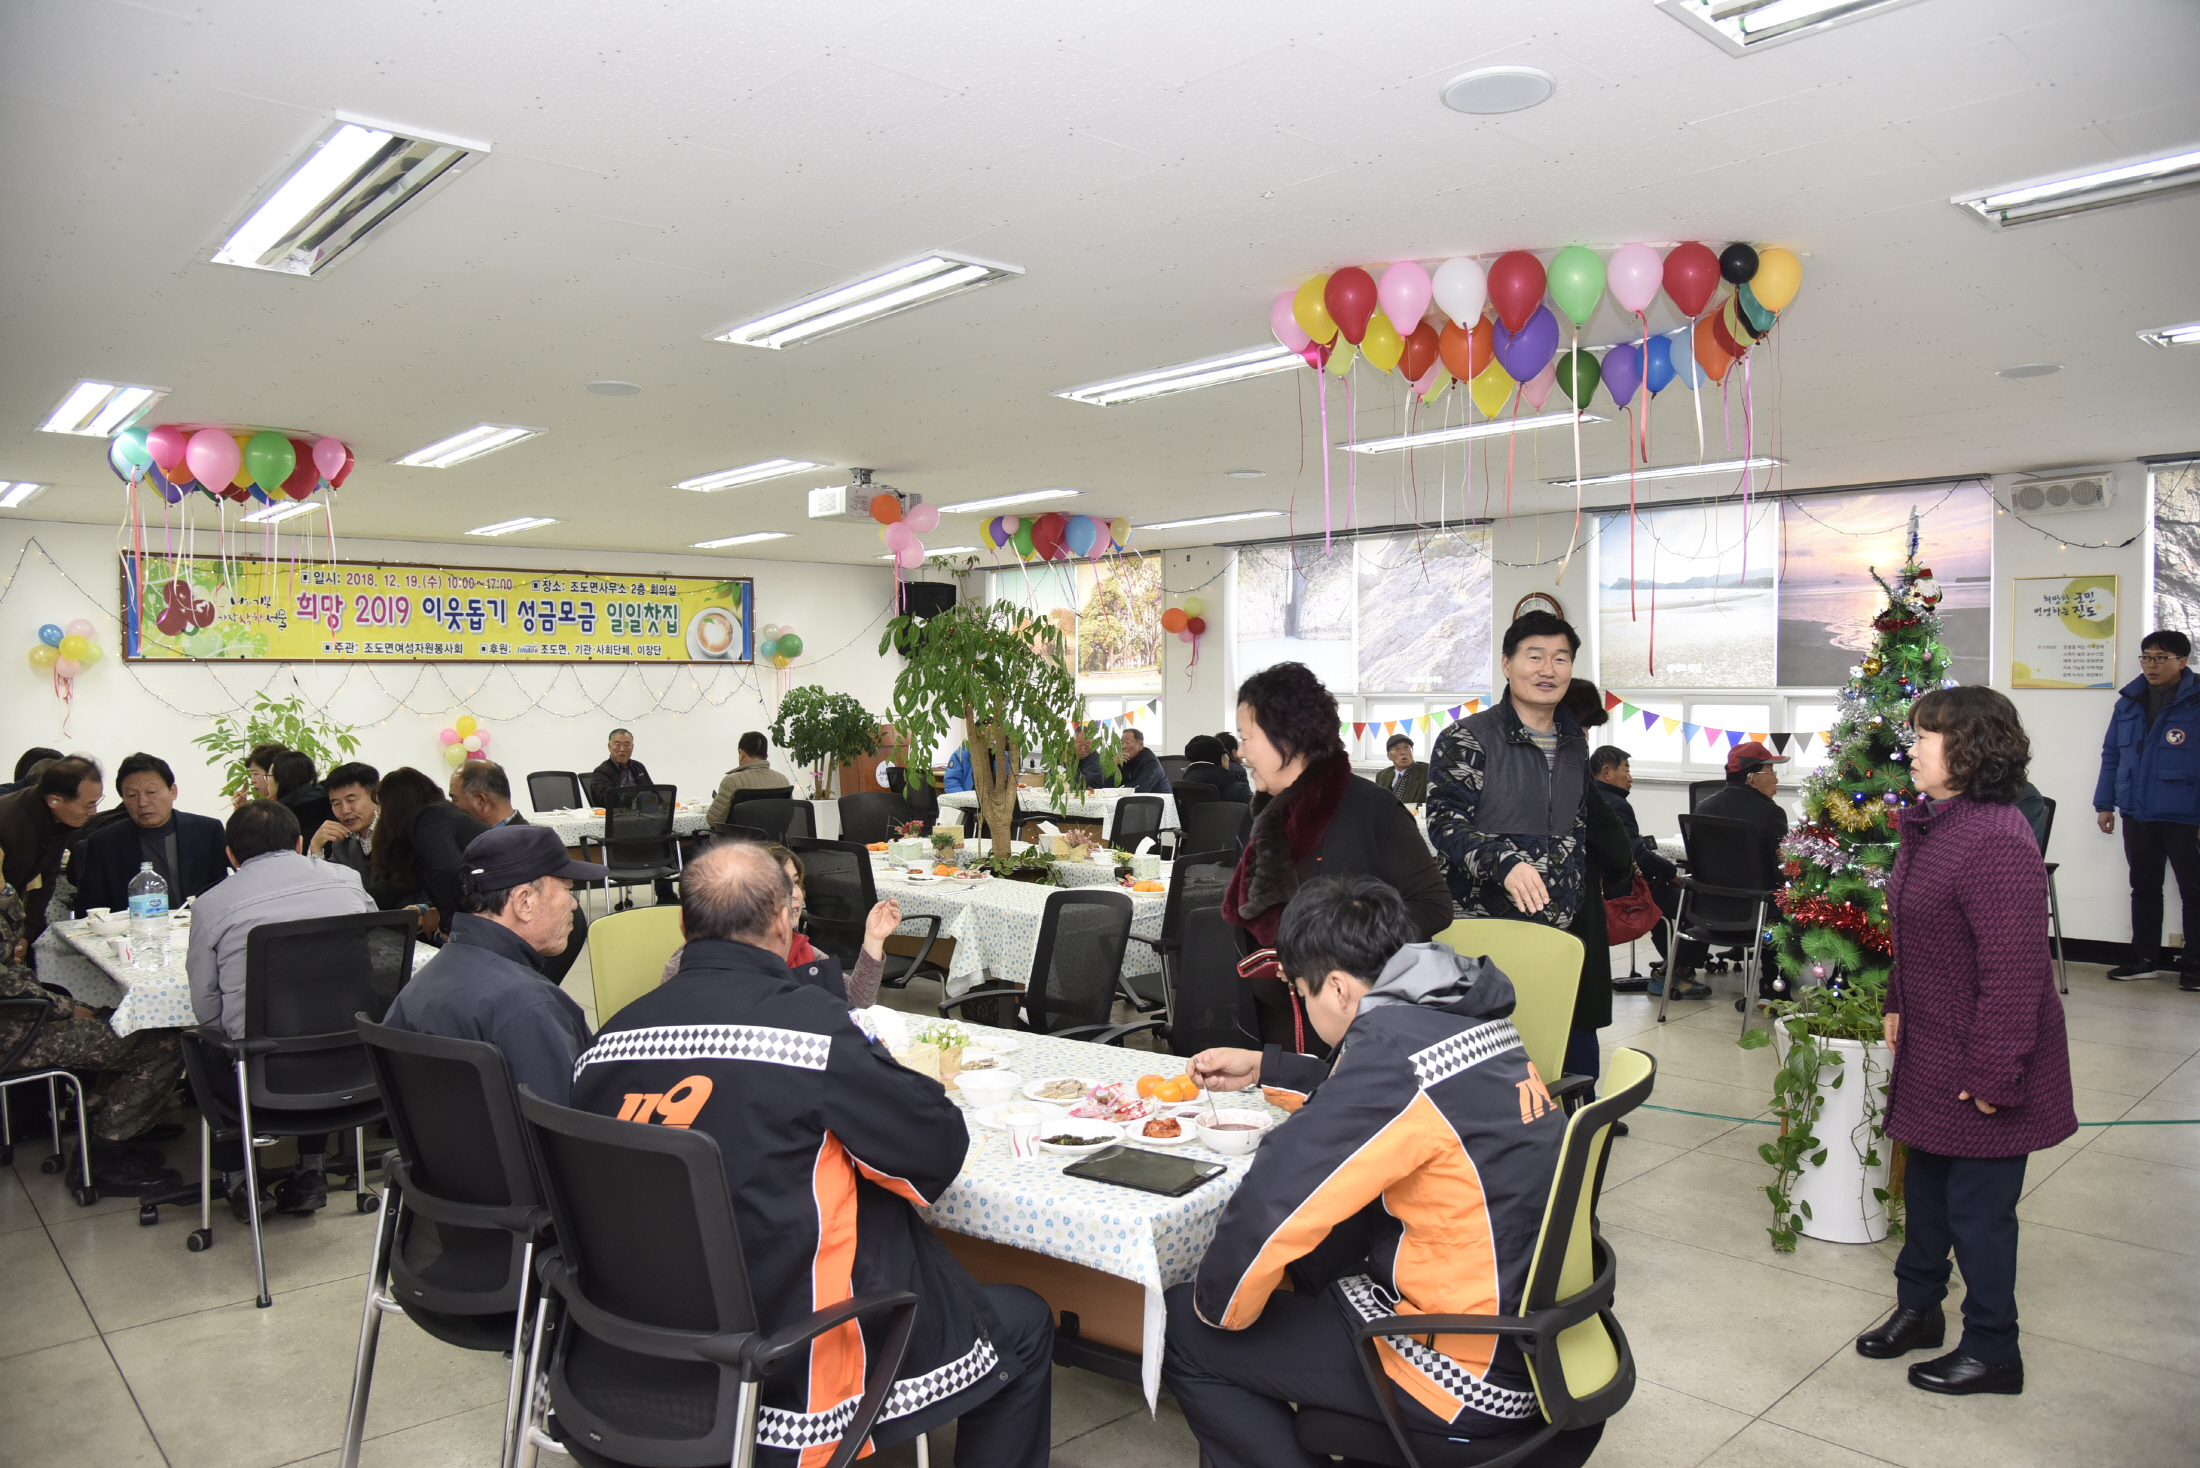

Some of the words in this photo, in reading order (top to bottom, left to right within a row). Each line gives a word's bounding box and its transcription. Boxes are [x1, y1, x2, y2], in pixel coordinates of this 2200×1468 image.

[313, 571, 341, 585] 일시:
[346, 572, 378, 587] 2018.
[384, 574, 400, 588] 12.
[542, 580, 566, 592] 장소:
[570, 581, 627, 594] 조도면사무소
[631, 583, 646, 596] 2층
[650, 583, 677, 597] 회의실
[296, 592, 344, 629] 희망
[355, 595, 410, 624] 2019
[422, 597, 506, 631] 이웃돕기
[517, 600, 596, 632] 성금모금
[606, 602, 678, 634] 일일찻집
[334, 642, 359, 654] 주관:
[364, 642, 464, 655] 조도면여성자원봉사회
[489, 644, 512, 655] 후원:
[540, 644, 570, 656] 조도면,
[637, 645, 662, 656] 이장단
[616, 1074, 714, 1130] 119
